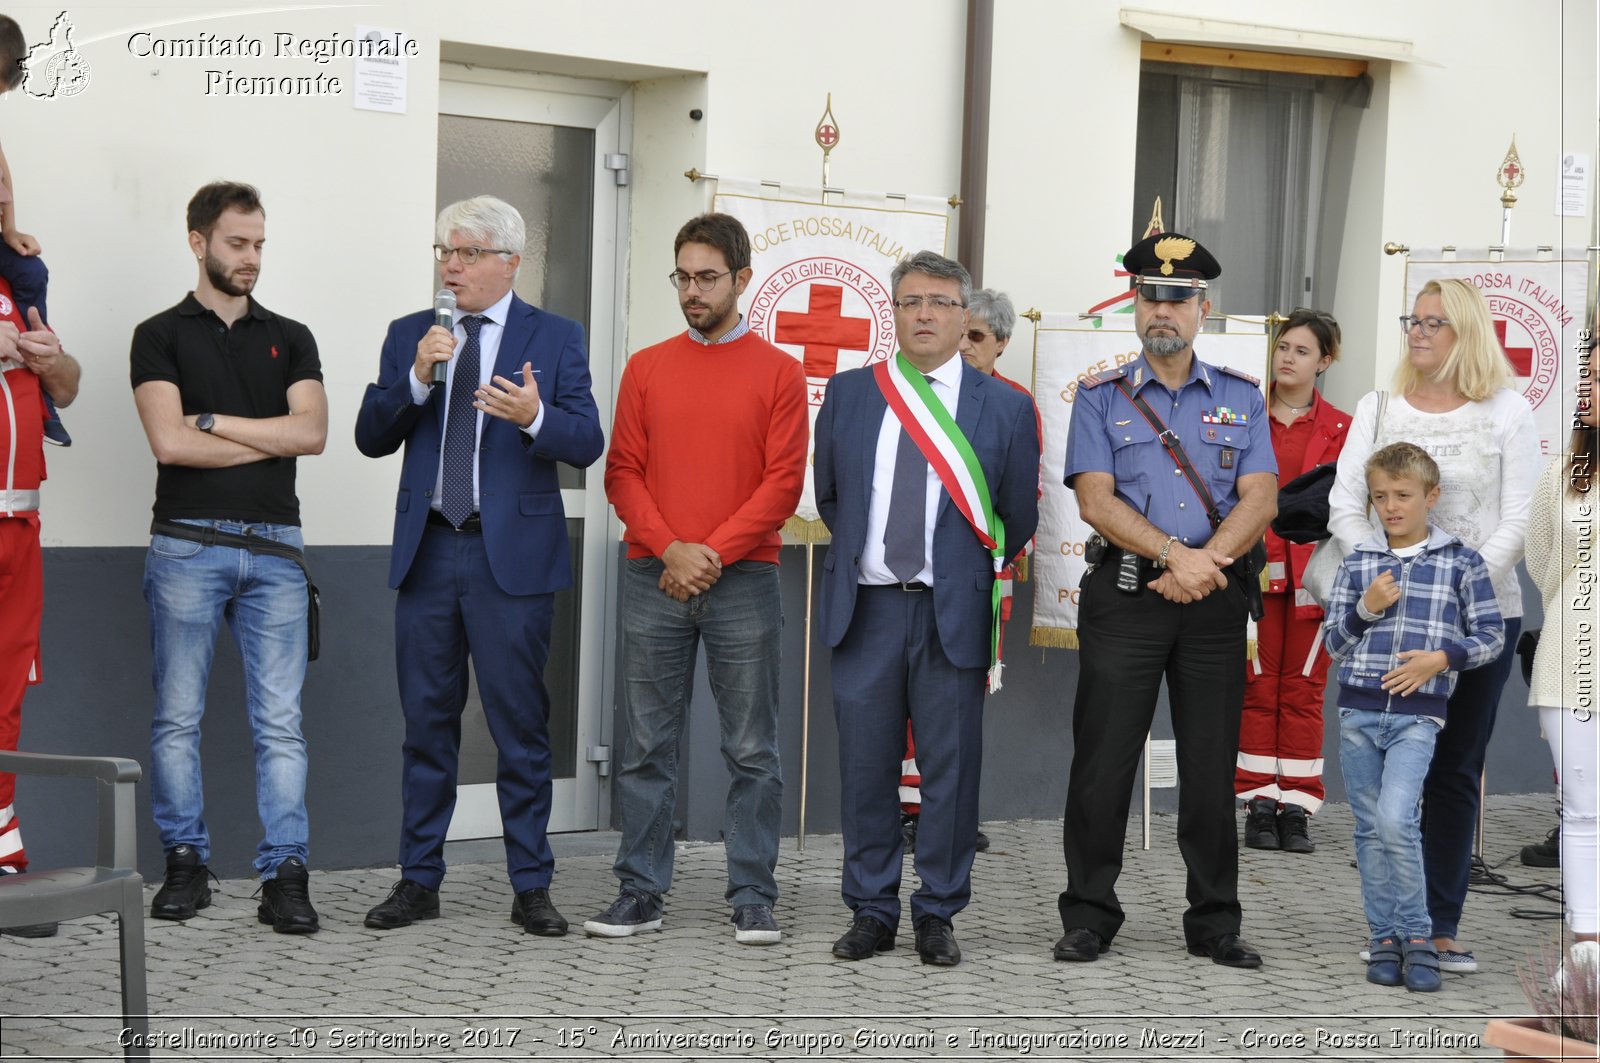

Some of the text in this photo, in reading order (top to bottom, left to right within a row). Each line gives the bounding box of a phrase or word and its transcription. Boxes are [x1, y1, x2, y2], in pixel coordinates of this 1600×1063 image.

[793, 216, 853, 240] ROSSA
[781, 268, 797, 284] DI
[799, 262, 863, 286] GINEVRA
[861, 281, 880, 299] 22
[874, 299, 894, 361] AGOSTO
[1518, 278, 1574, 328] ITALIANA
[1523, 313, 1541, 330] 22
[1536, 328, 1554, 385] AGOSTO
